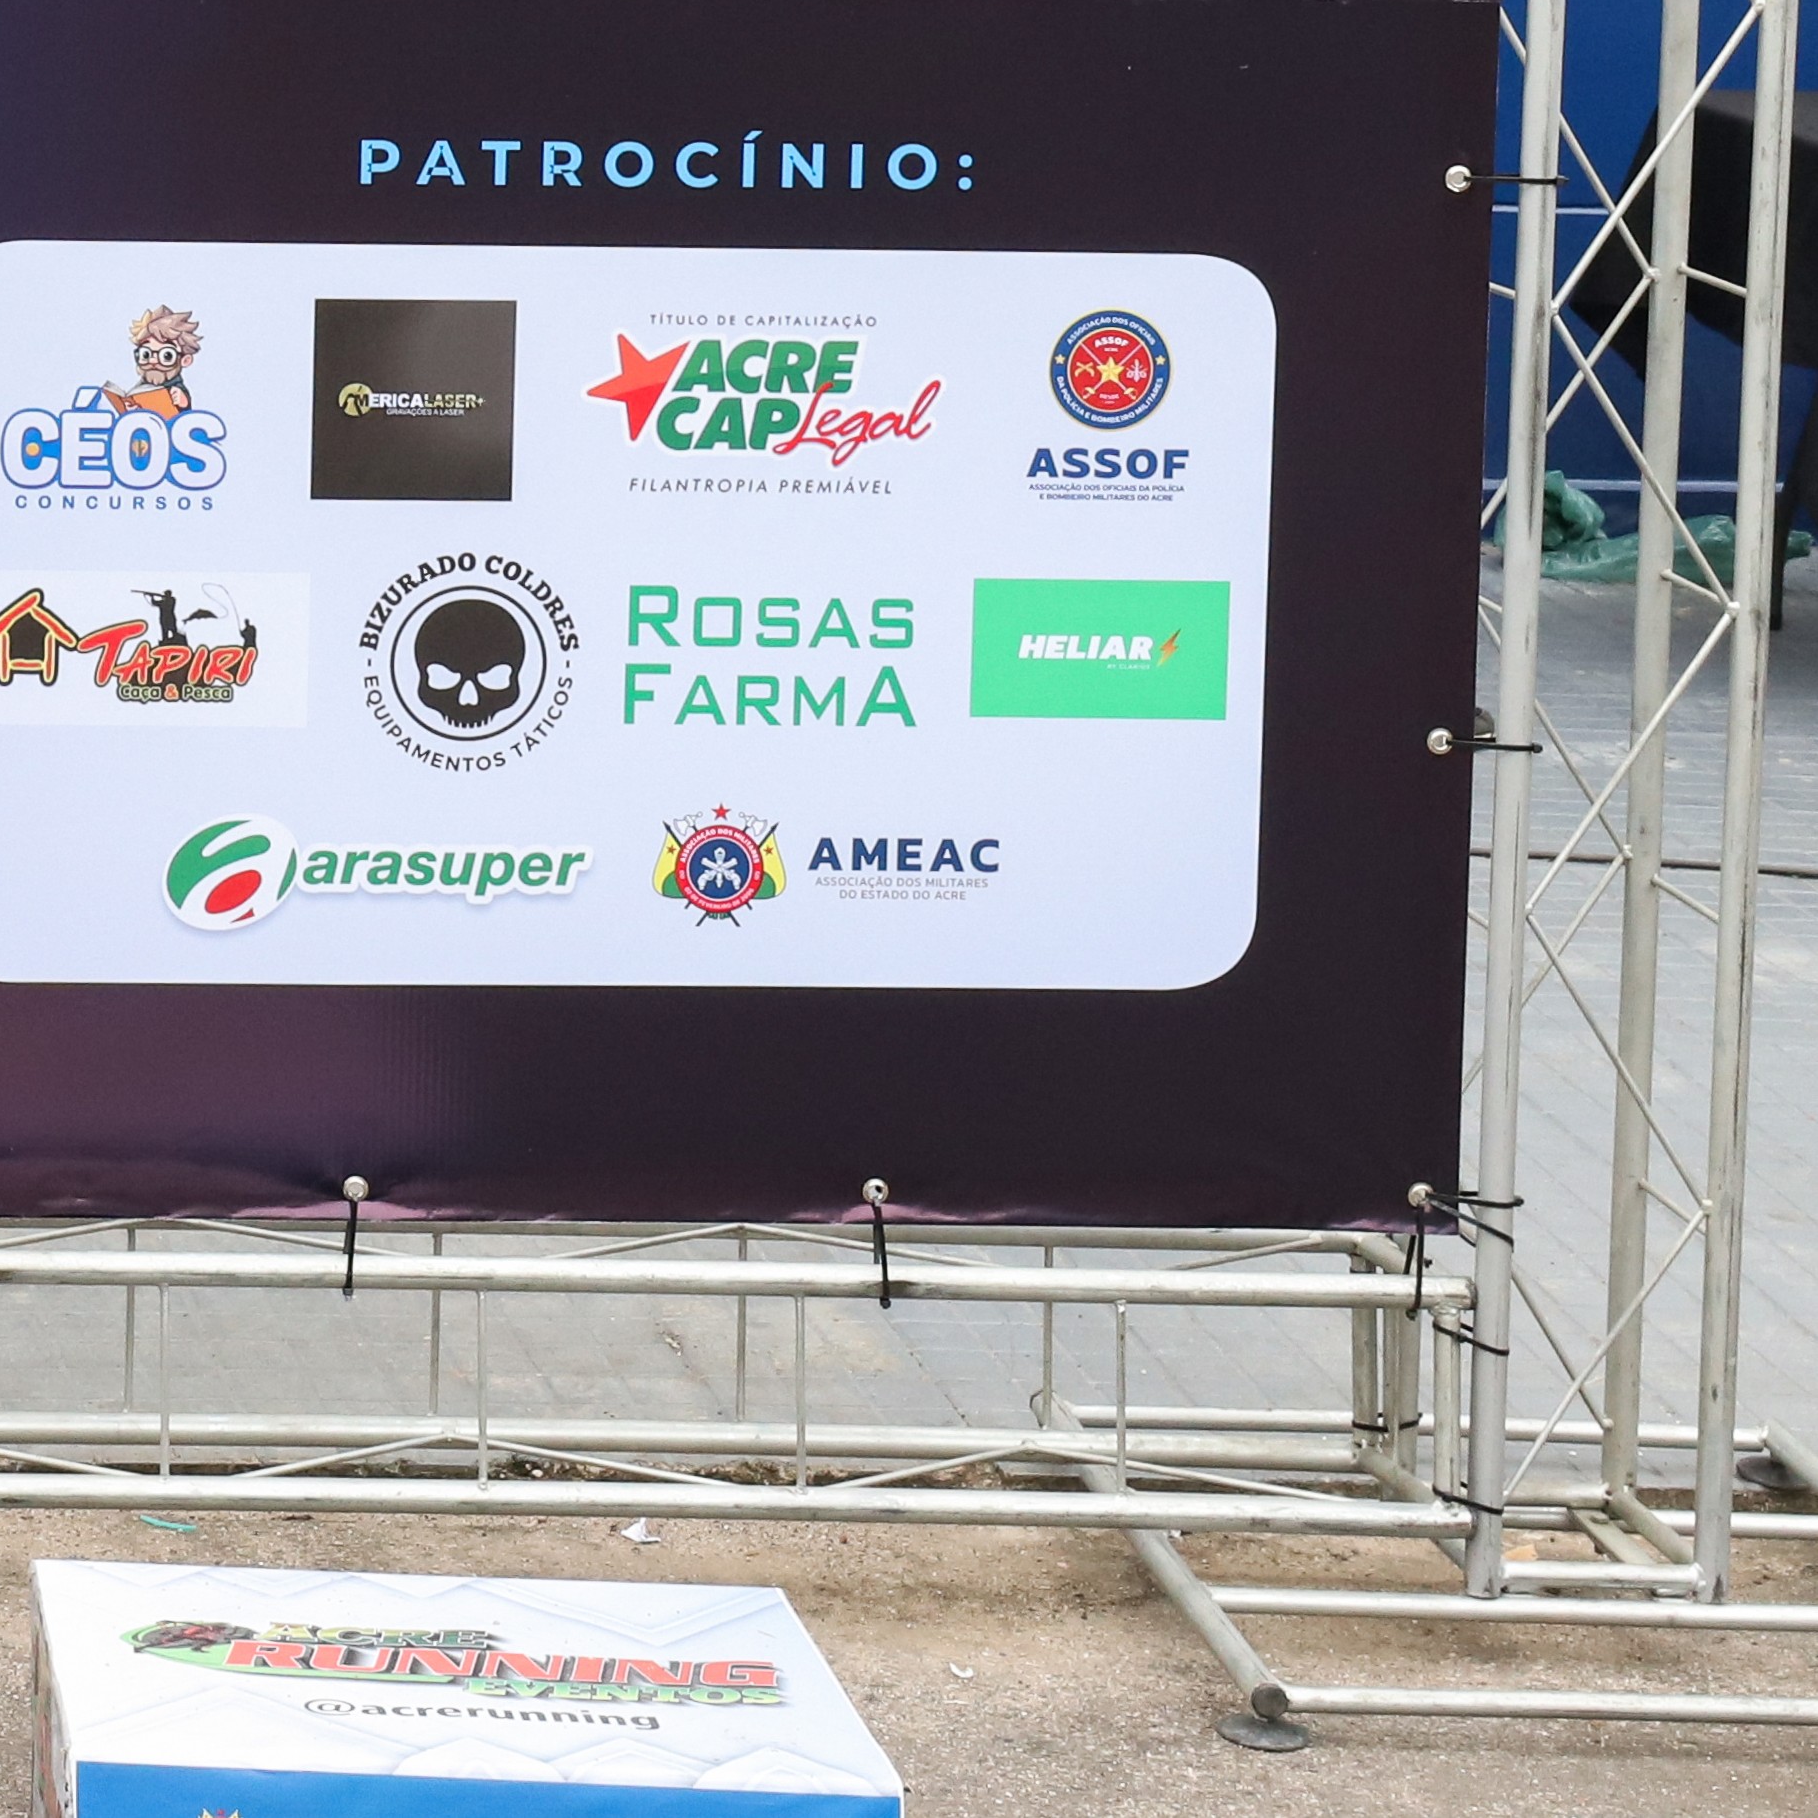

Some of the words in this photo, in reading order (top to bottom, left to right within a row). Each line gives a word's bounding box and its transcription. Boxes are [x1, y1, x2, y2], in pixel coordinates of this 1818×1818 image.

[359, 130, 974, 191] PATROCÍNIO:
[650, 312, 709, 326] TÍTULO
[717, 314, 737, 327] DE
[744, 314, 878, 330] CAPITALIZAÇÃO
[1093, 336, 1131, 348] ASSOF
[671, 338, 860, 395] ACRE
[0, 385, 227, 490] CÉOS
[656, 395, 802, 452] CAP
[772, 379, 942, 467] Legal
[1026, 447, 1190, 480] ASSOF
[14, 494, 215, 512] CONCURSOS
[628, 477, 768, 494] FILANTROPIA
[778, 476, 893, 495] PREMIÁVEL
[1028, 483, 1082, 493] ASSOCIAÇÃO
[358, 551, 477, 652] BIZURADO
[484, 554, 581, 653] COLDRES
[627, 584, 916, 650] ROSAS
[76, 620, 260, 688] TAPIRI
[1018, 634, 1154, 661] HELIAR
[116, 683, 161, 705] Caça
[163, 683, 180, 701] &
[181, 684, 234, 703] Pesca
[622, 662, 918, 728] FARMA
[363, 674, 507, 773] EQUIPAMENTOS
[509, 675, 574, 759] TÁTICOS
[302, 843, 586, 897] arasuper
[808, 837, 1000, 874] AMEAC
[815, 876, 893, 889] ASSOCIAÇÃO
[896, 877, 918, 888] DOS
[925, 877, 989, 889] MILITARES
[839, 889, 857, 900] DO
[861, 889, 909, 901] ESTADO
[913, 890, 931, 900] DO
[934, 890, 967, 901] ACRE
[254, 1621, 489, 1649] ACRE
[222, 1638, 780, 1687] RUNNING
[471, 1678, 782, 1705] EVENTOS
[303, 1697, 661, 1732] @acrerunning
